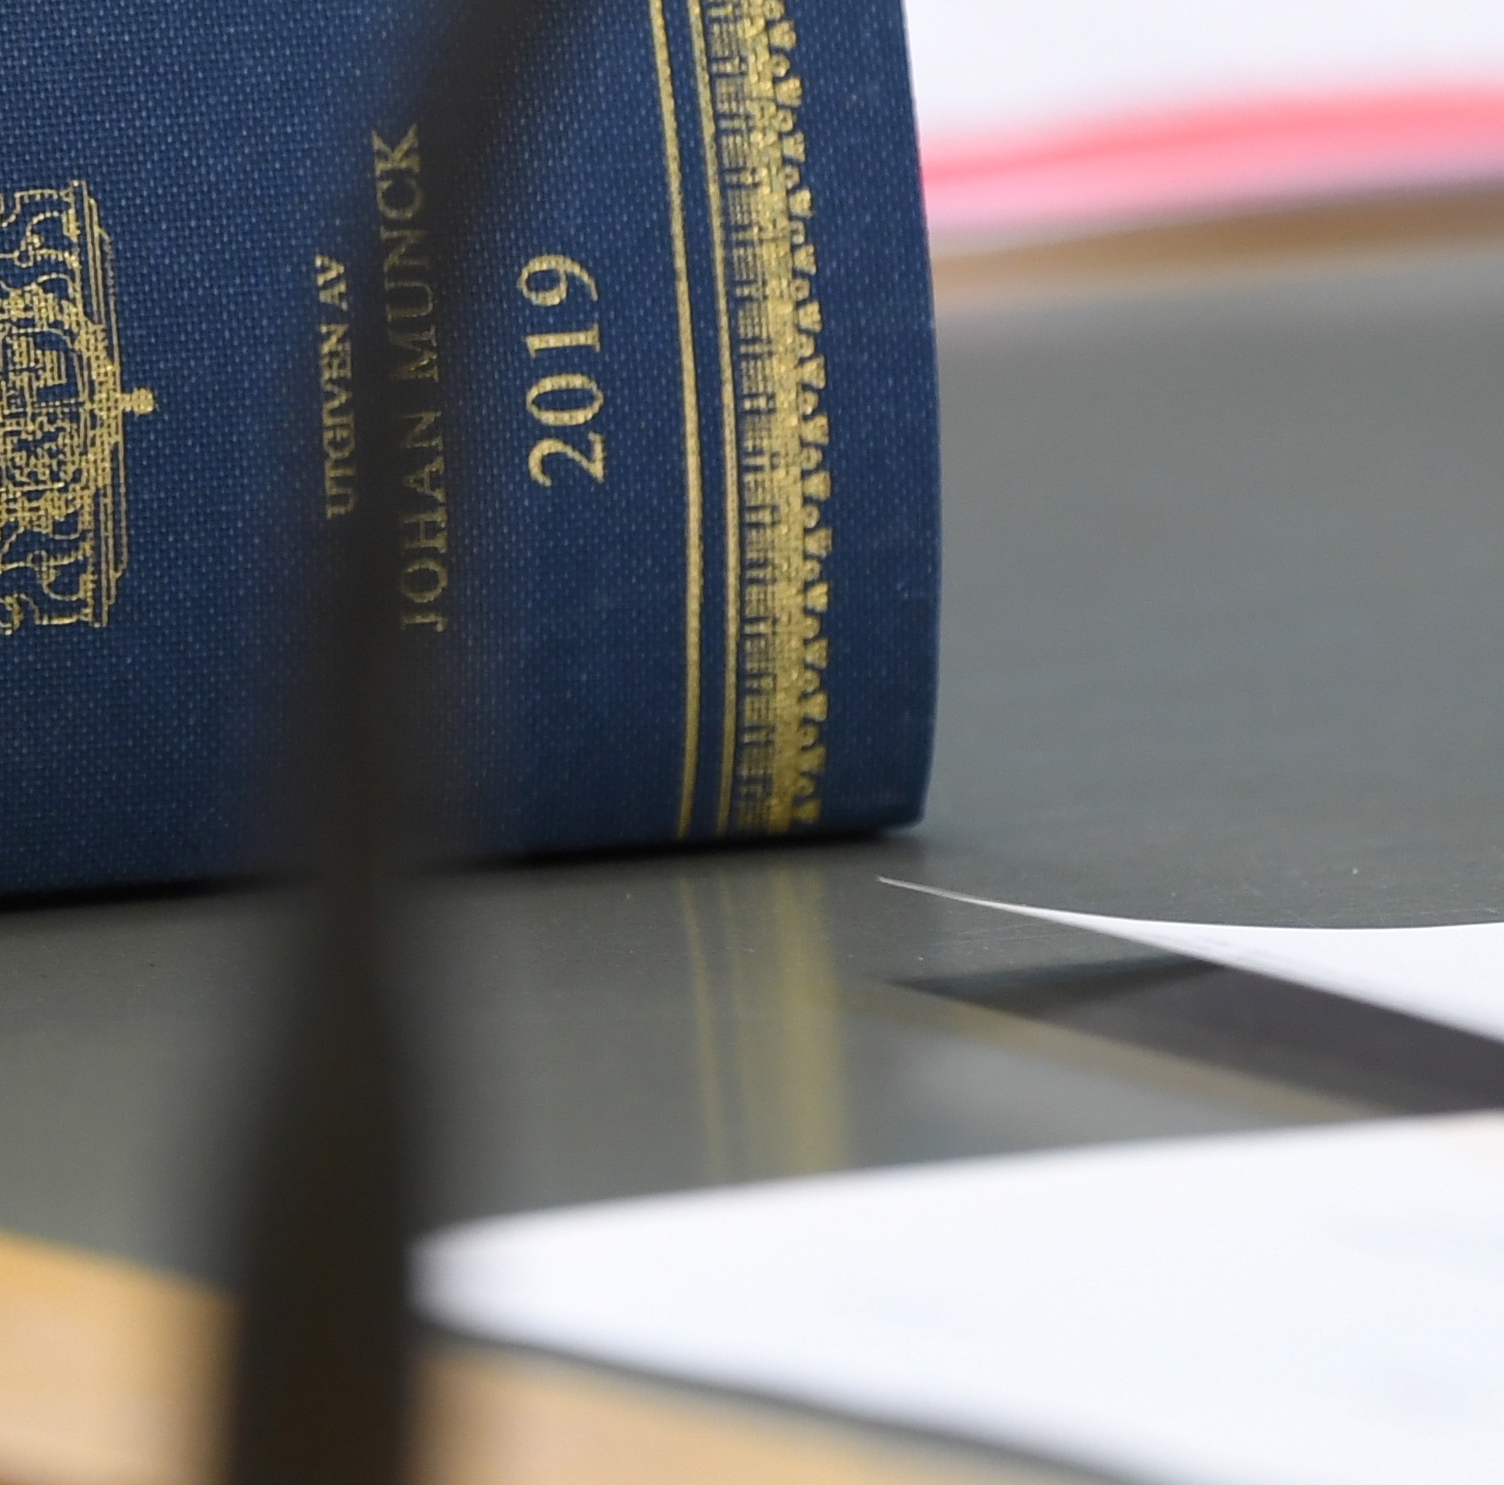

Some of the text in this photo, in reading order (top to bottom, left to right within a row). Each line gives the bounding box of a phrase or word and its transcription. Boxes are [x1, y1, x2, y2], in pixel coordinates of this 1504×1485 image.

[314, 253, 357, 519] UTGIVEN AV
[371, 123, 449, 633] JOHAN MUNCK
[516, 253, 606, 486] 2019
